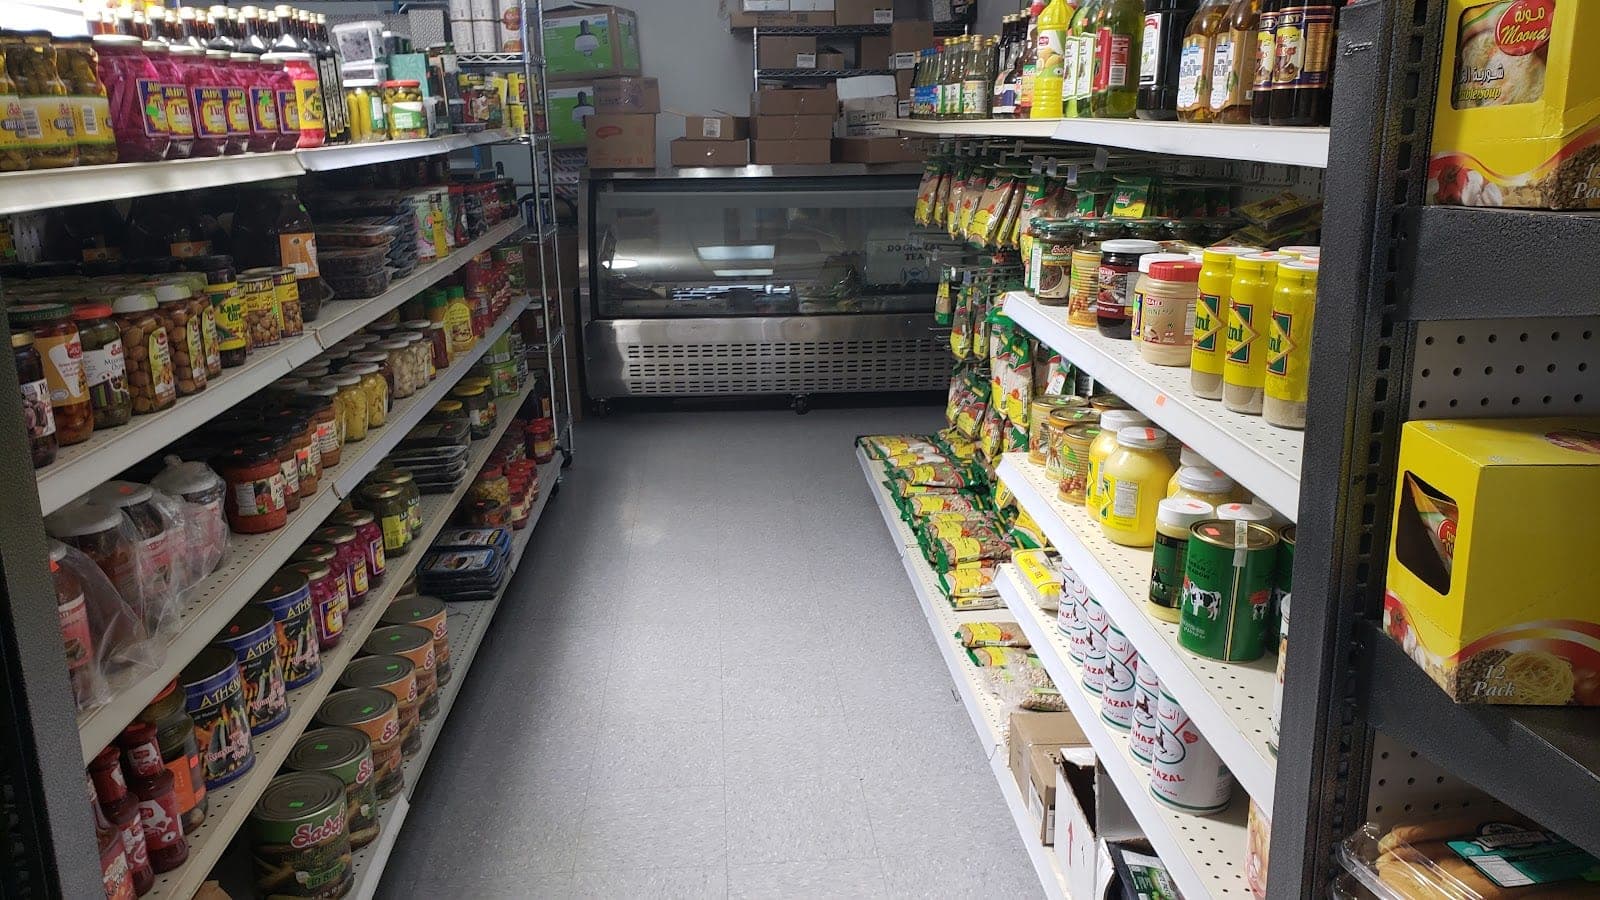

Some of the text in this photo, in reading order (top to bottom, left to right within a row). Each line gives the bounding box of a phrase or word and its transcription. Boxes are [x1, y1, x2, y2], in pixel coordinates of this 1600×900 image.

[1515, 3, 1545, 25] مونة
[1500, 25, 1548, 45] Moona
[1485, 665, 1506, 680] 12
[1472, 681, 1516, 697] Pack
[290, 803, 346, 849] Sadaf
